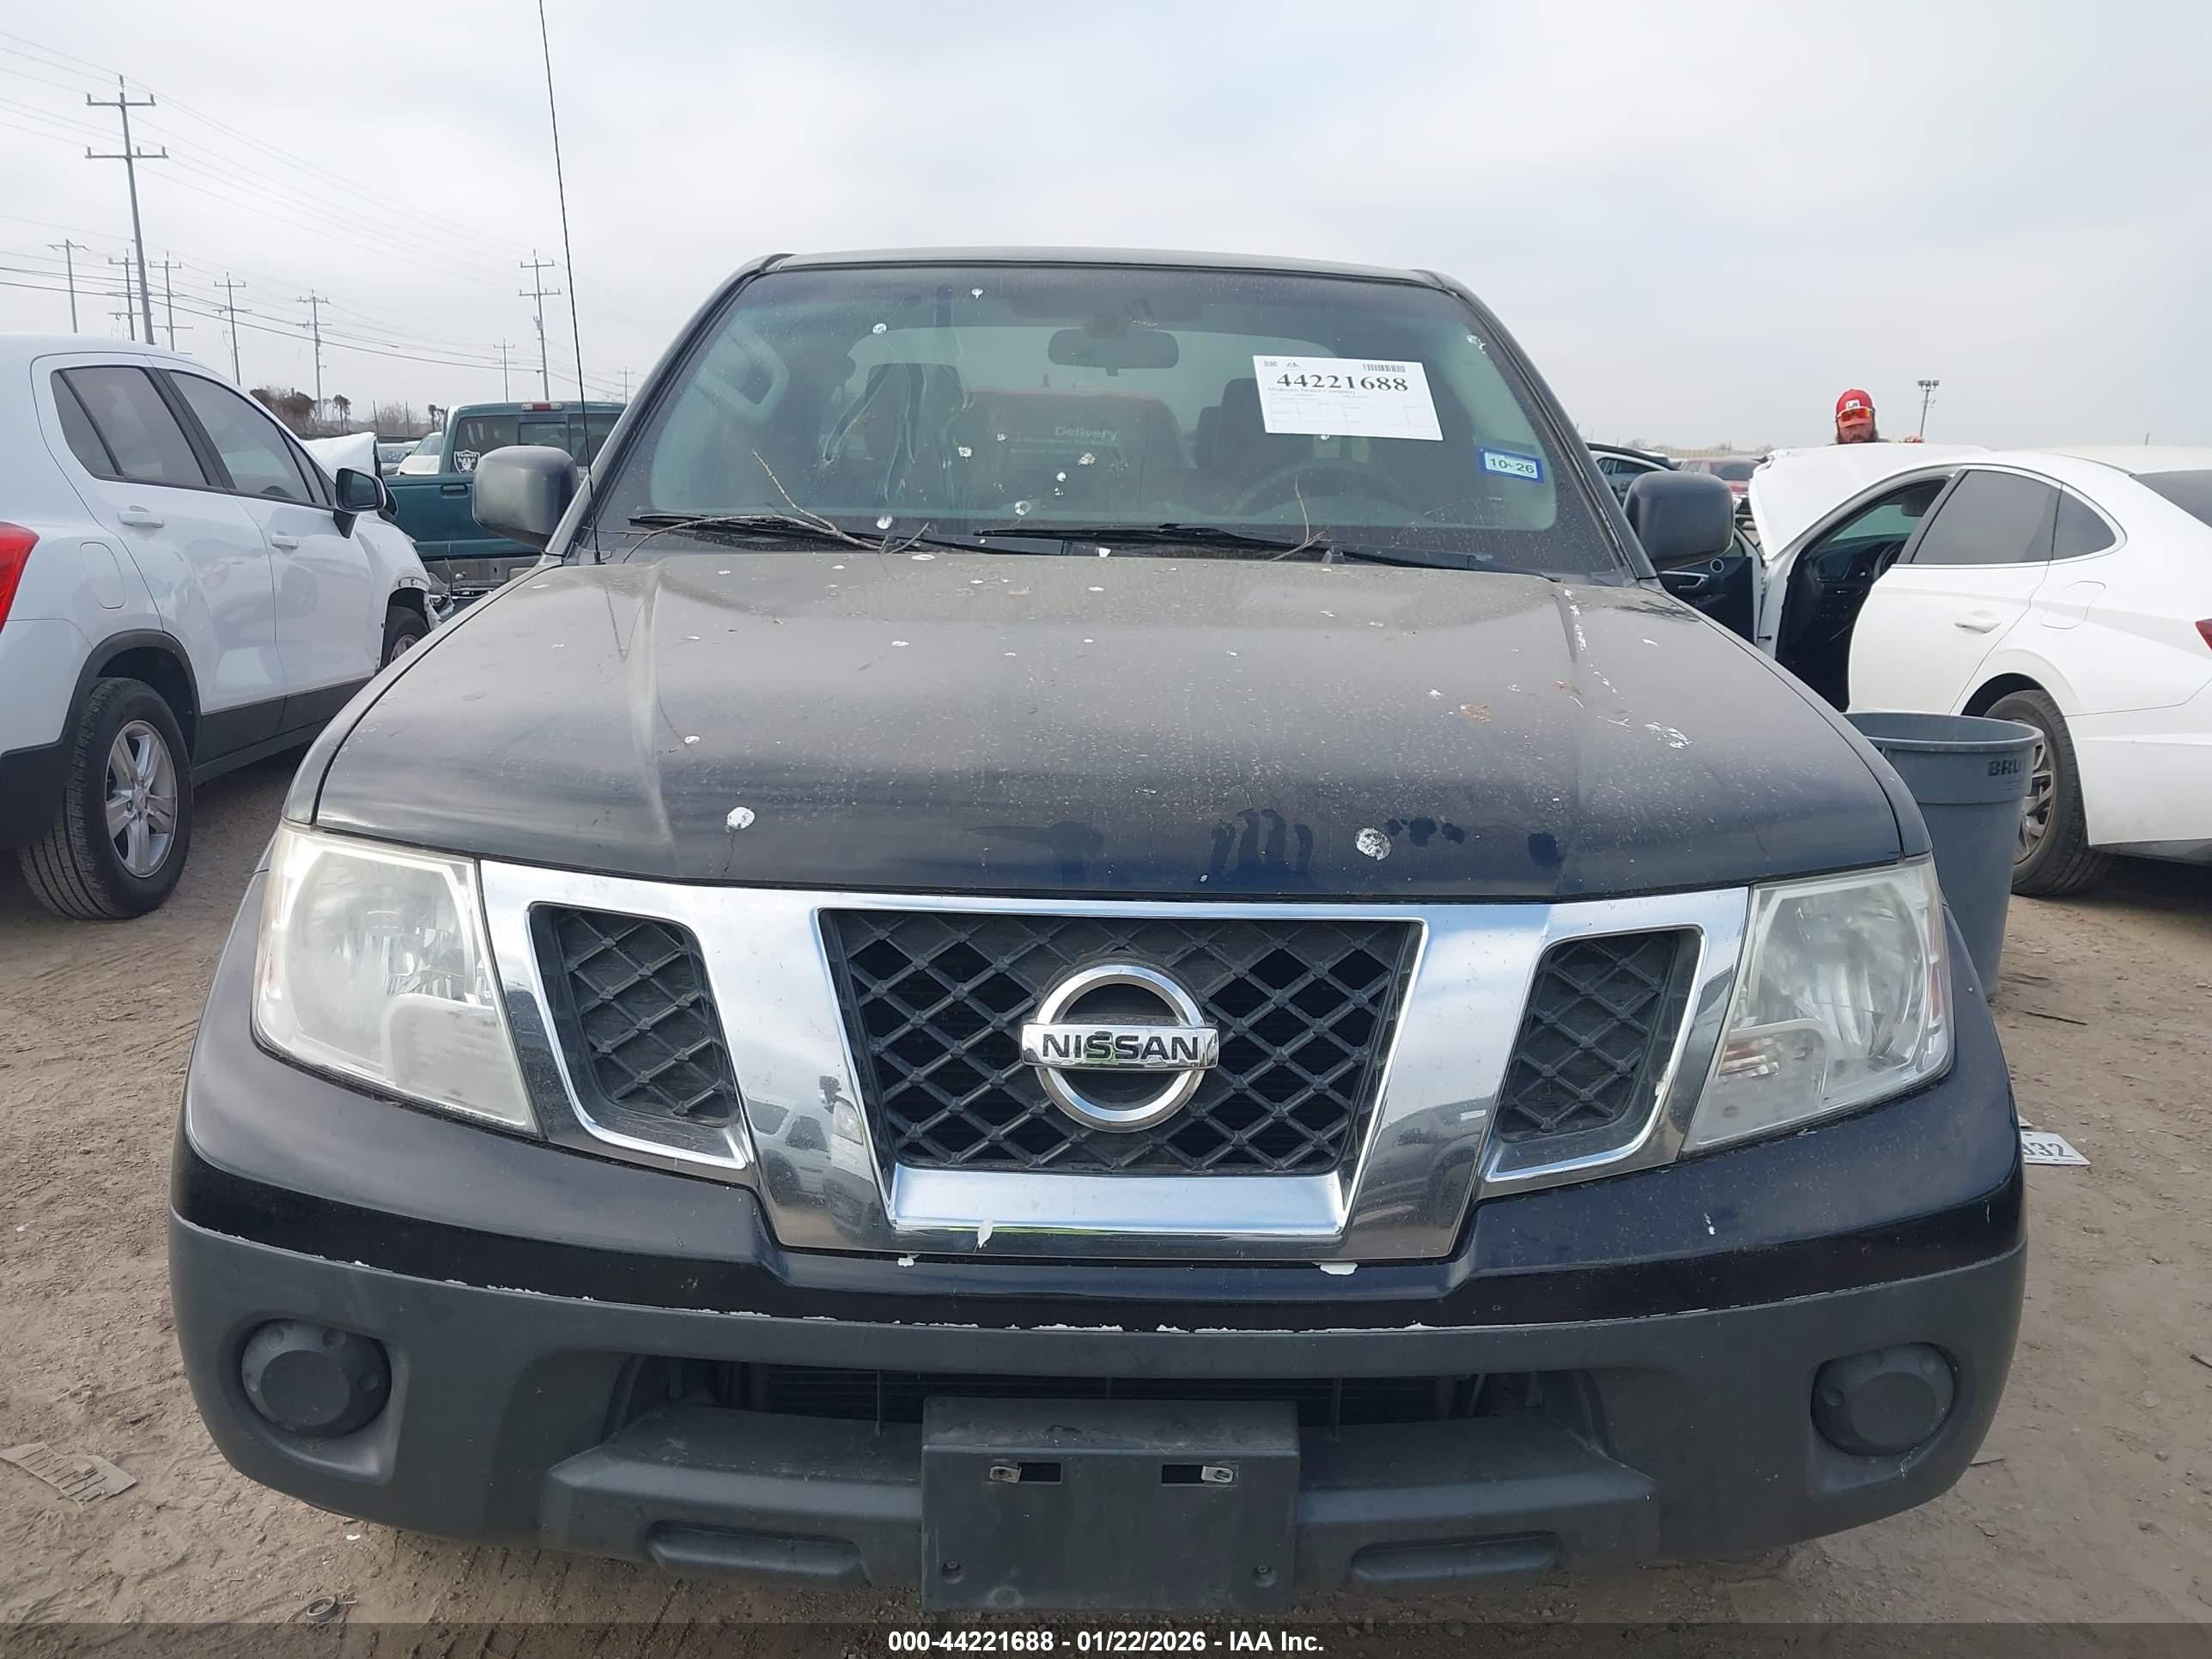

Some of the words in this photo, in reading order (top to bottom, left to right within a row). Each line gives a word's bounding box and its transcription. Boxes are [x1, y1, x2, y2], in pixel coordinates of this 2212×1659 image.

[1276, 373, 1409, 392] 44221688
[1054, 426, 1119, 442] Delivery
[1042, 1031, 1199, 1061] NISSAN
